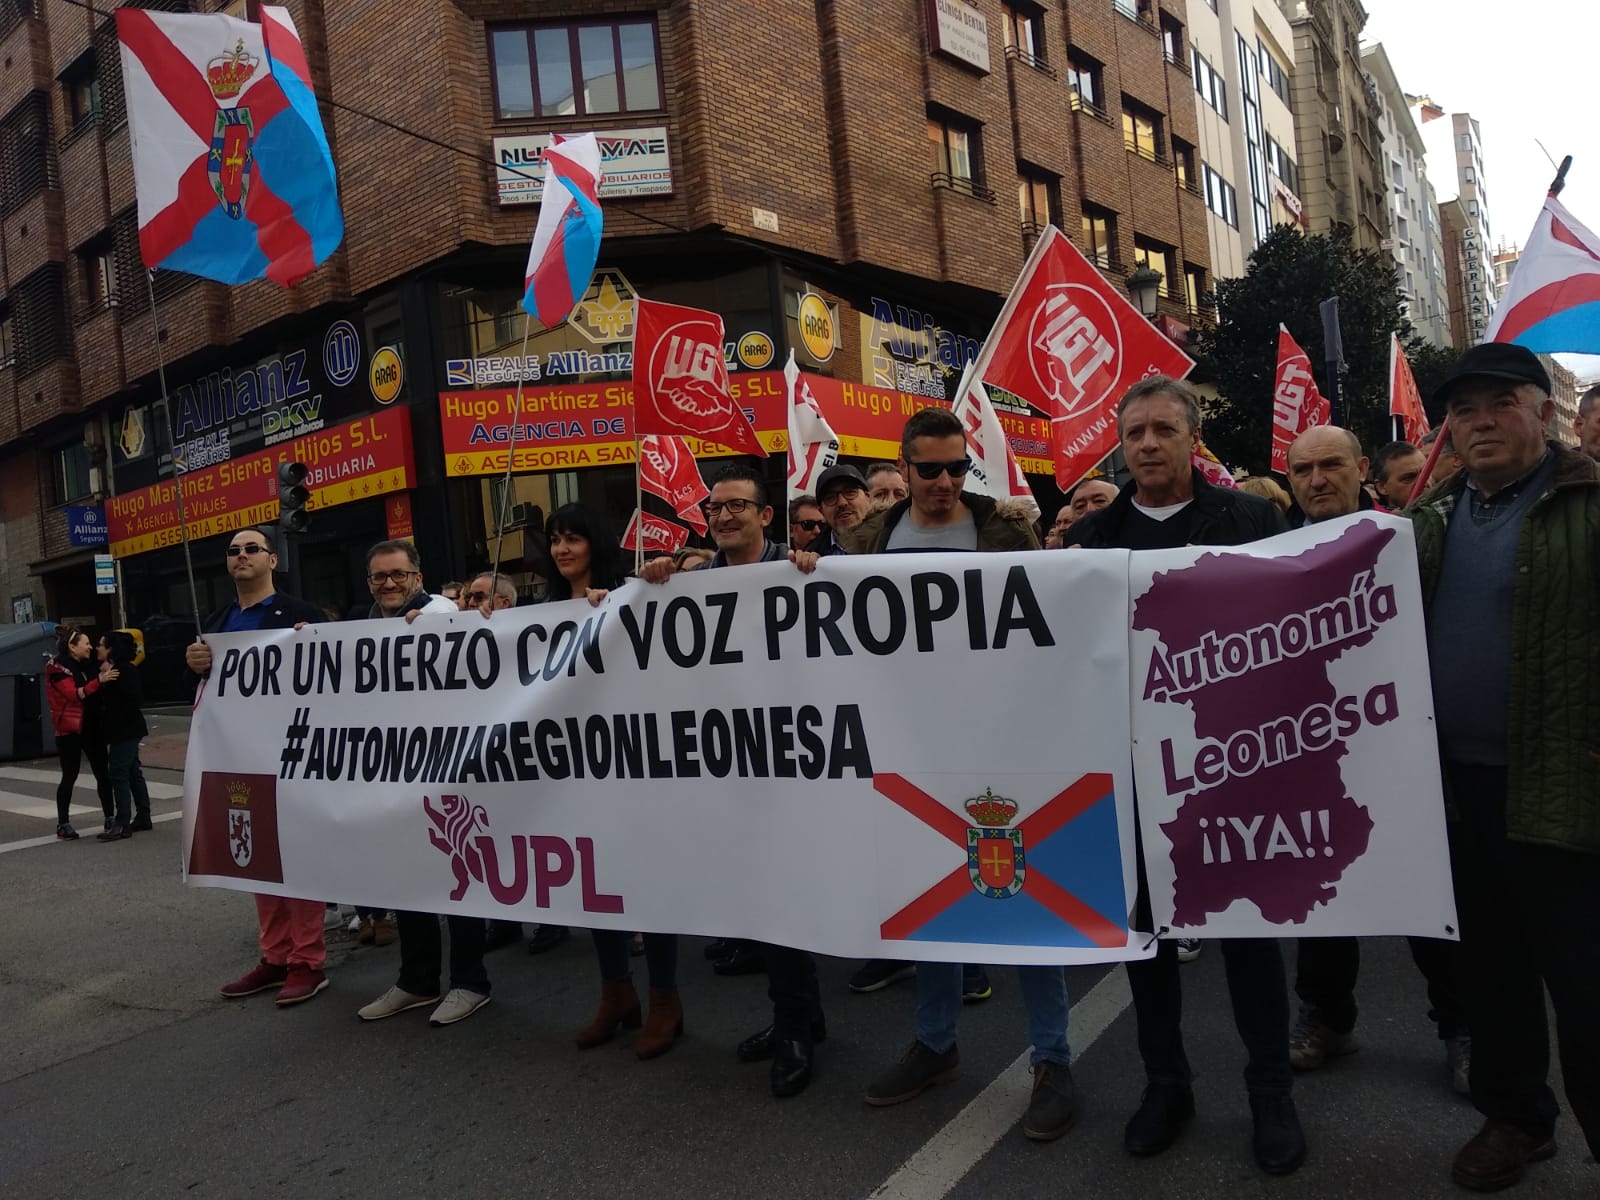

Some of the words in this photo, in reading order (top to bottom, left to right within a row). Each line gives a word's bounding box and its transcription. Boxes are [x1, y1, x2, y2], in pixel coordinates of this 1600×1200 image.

[635, 182, 672, 193] Traspasos
[805, 314, 830, 340] ARAG
[869, 296, 984, 372] Allian
[476, 357, 540, 372] REALE
[547, 350, 633, 376] Allianz
[745, 345, 764, 357] ARAG
[375, 364, 397, 387] ARAG
[476, 370, 540, 383] SEGUROS
[896, 360, 945, 387] REALE
[896, 379, 946, 400] SEGUROS
[176, 349, 310, 439] Allianz
[446, 397, 500, 421] Hugo
[506, 391, 599, 414] Martínez
[747, 376, 782, 397] S.L.
[842, 382, 892, 416] Hugo
[1273, 363, 1312, 433] UGT
[262, 394, 322, 436] DKV
[470, 420, 586, 445] AGENCIA
[593, 418, 625, 436] DE
[187, 427, 231, 455] REALE
[112, 495, 145, 519] Hugo
[150, 474, 214, 508] Martínez
[219, 456, 273, 488] Sierra
[294, 435, 343, 466] Hijos
[350, 417, 388, 448] S.L.
[188, 446, 231, 471] SEGUROS
[481, 449, 591, 471] ASESORIA
[596, 446, 636, 463] SAN
[74, 525, 108, 535] Allianz
[137, 511, 175, 534] AGENCIA
[191, 496, 228, 518] VIAJES
[153, 522, 212, 549] ASESORIA
[216, 512, 243, 529] SAN
[217, 643, 282, 698] POR
[293, 639, 343, 695] UN
[354, 628, 501, 694] BIERZO
[516, 611, 608, 687] CON
[619, 591, 744, 671] VOZ
[763, 565, 1056, 661] PROPIA
[1142, 569, 1399, 702] Autonomía
[280, 703, 875, 784] #AUTONOMIAREGIONLEONESA
[1160, 681, 1399, 797] Leonesa
[1199, 809, 1335, 866] ¡¡YA!!
[474, 835, 625, 914] UPL
